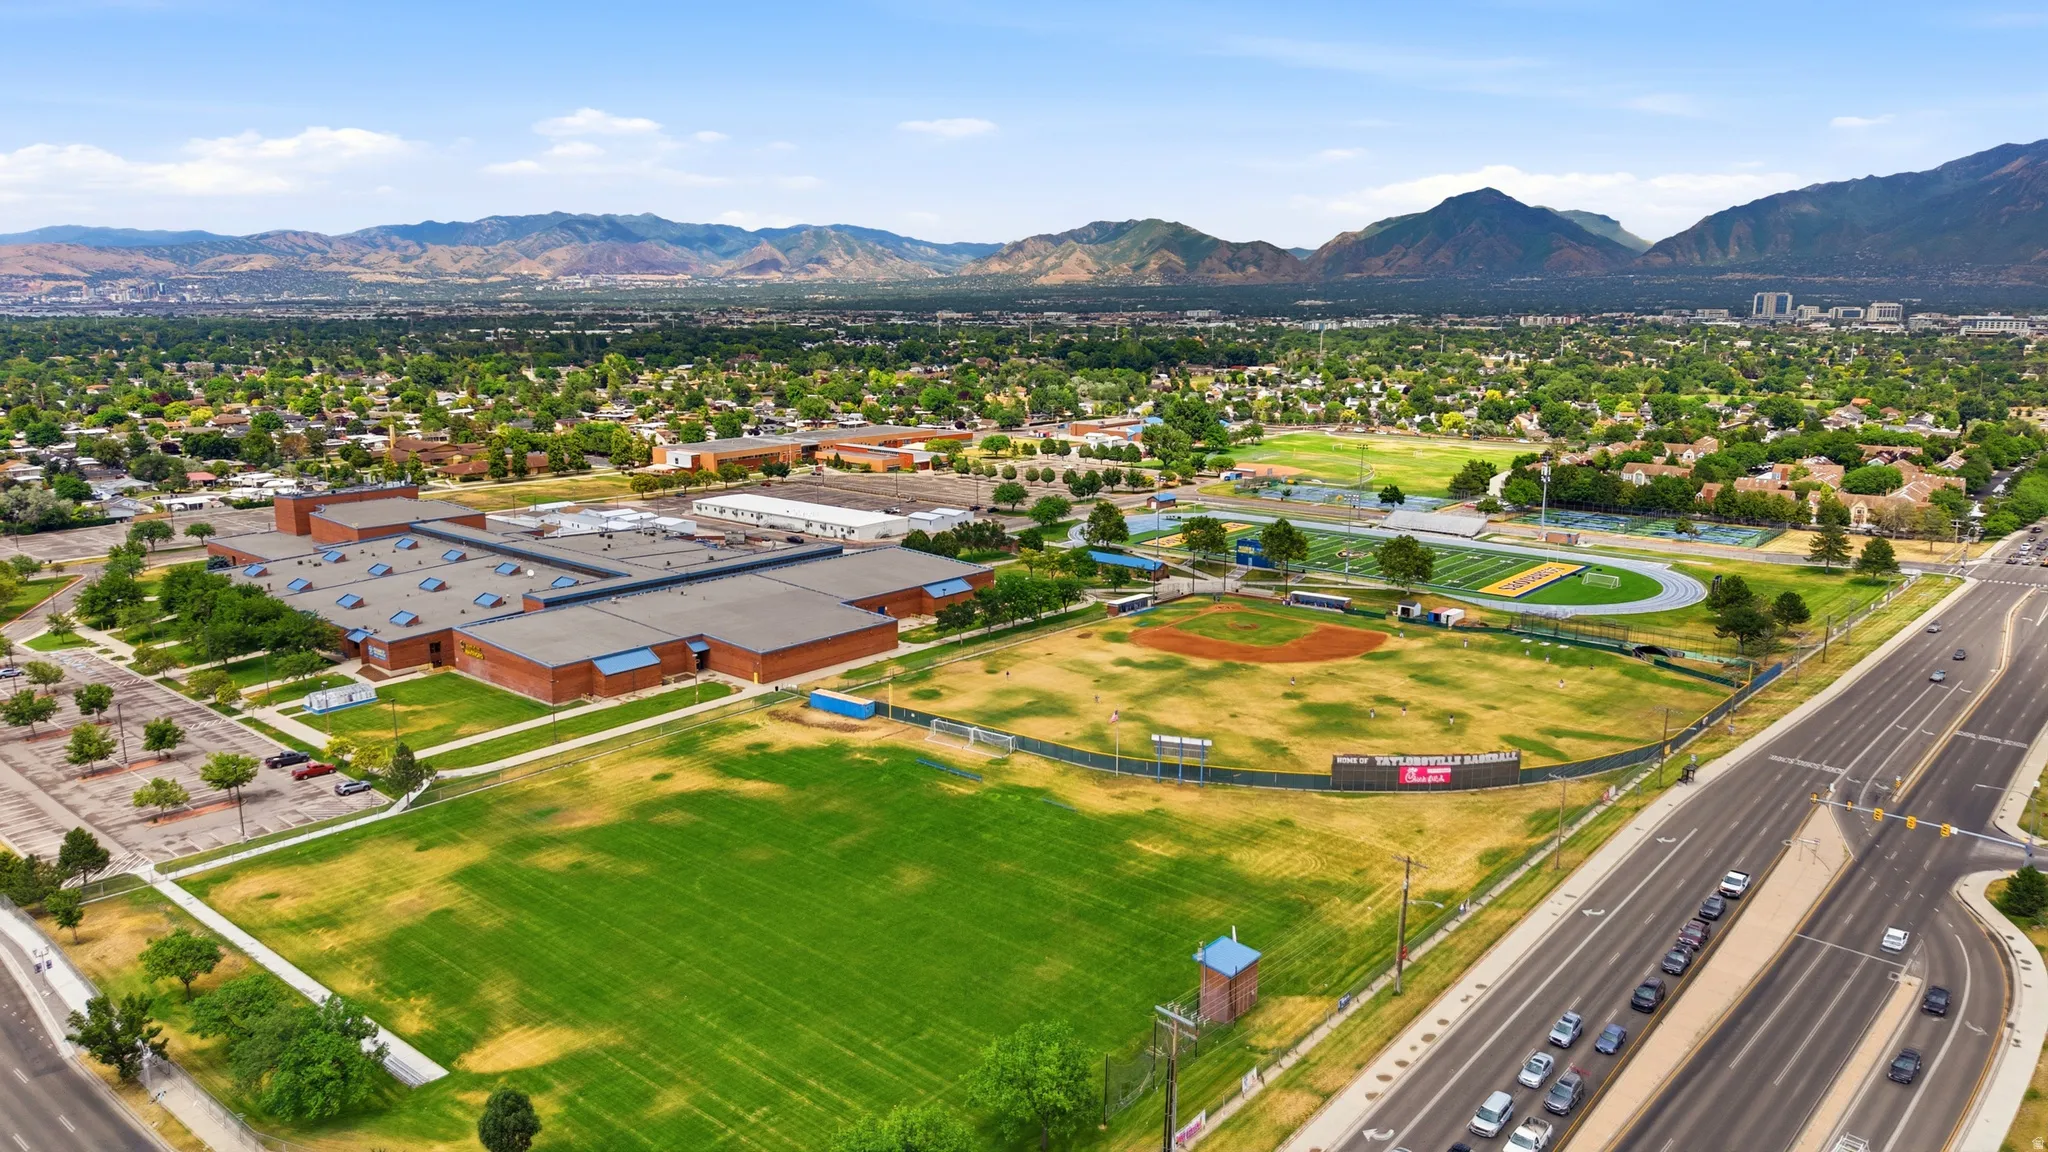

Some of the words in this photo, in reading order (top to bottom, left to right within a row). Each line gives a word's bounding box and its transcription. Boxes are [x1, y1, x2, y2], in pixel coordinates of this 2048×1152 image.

[1336, 757, 1358, 765] HOME
[1359, 757, 1369, 765] OF
[1375, 755, 1461, 767] TAYLORSVILLE
[1463, 751, 1518, 765] BASEBALL
